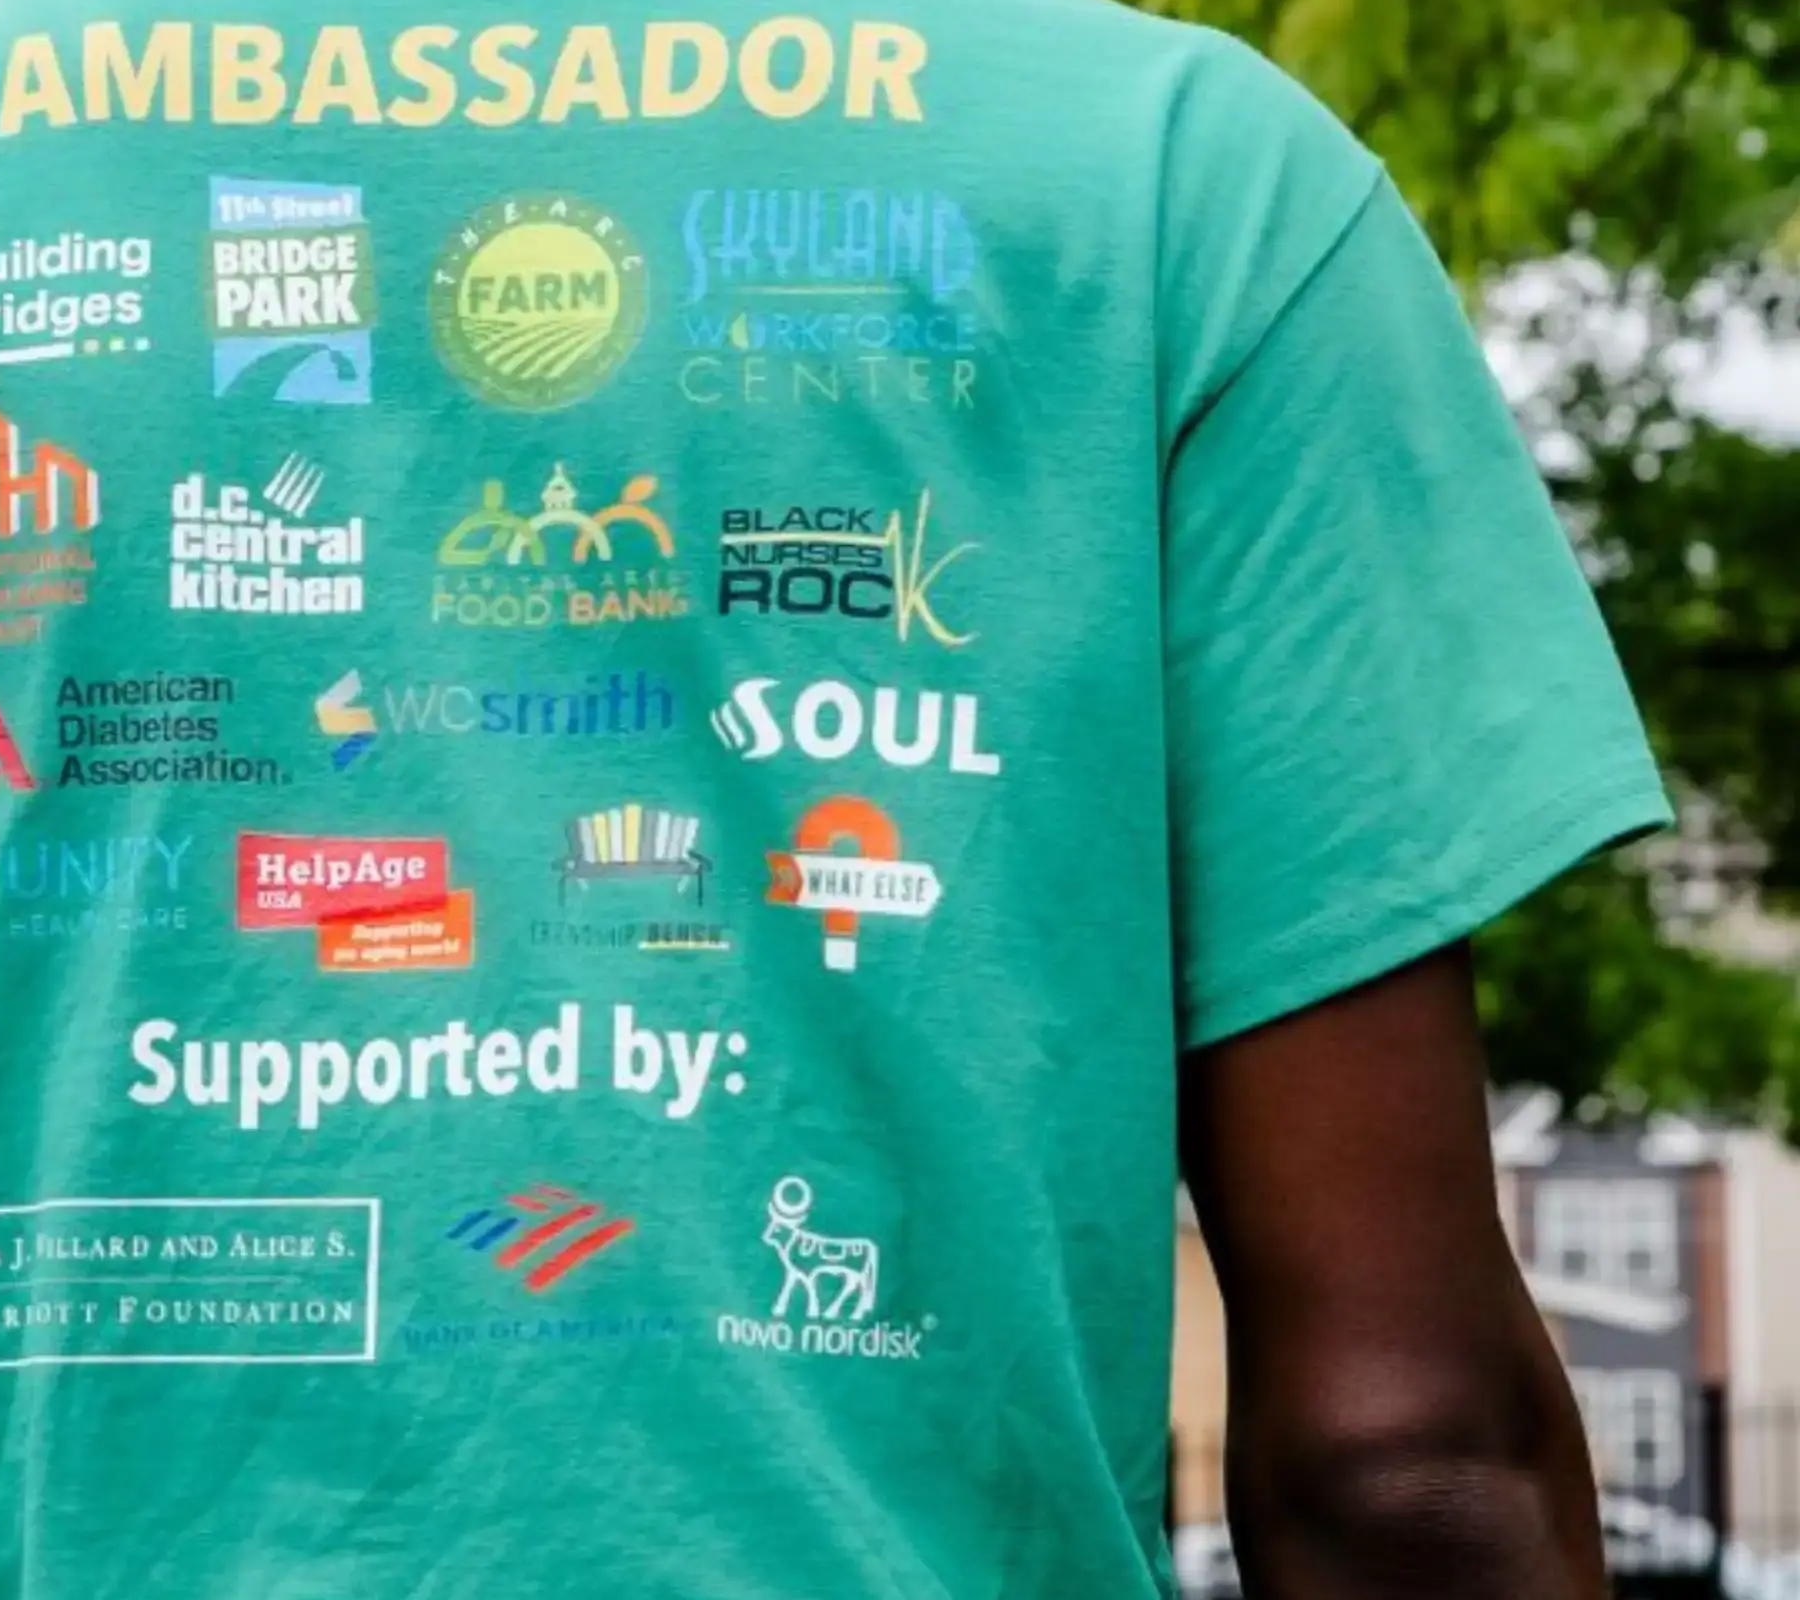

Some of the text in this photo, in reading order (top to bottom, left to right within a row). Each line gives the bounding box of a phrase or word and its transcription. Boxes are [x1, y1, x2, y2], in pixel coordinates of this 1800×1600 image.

[220, 195, 266, 223] 11th
[213, 234, 358, 275] BRIDGE
[680, 188, 977, 304] SKYLAND
[216, 273, 362, 328] PARK
[467, 270, 608, 314] FARM
[682, 312, 978, 352] WORKFORCE
[679, 356, 977, 410] CENTER
[170, 472, 265, 521] d.c.
[721, 507, 874, 534] BLACK
[170, 517, 363, 565] central
[720, 542, 884, 568] NURSES
[169, 563, 363, 614] kitchen
[431, 587, 689, 626] FOOD BANK
[56, 669, 234, 709] American
[57, 711, 219, 750] Diabetes
[711, 677, 1000, 776] SOUL
[7, 834, 195, 900] UNITY
[256, 850, 427, 891] HelpAge
[806, 868, 929, 904] WHAT ELSE
[256, 890, 303, 910] USA
[127, 1001, 748, 1130] Supported by:
[159, 1234, 219, 1262] AND
[228, 1232, 317, 1260] ALICE
[326, 1229, 357, 1258] S.
[118, 1294, 353, 1325] FOUNDATION
[717, 1313, 795, 1351] novo
